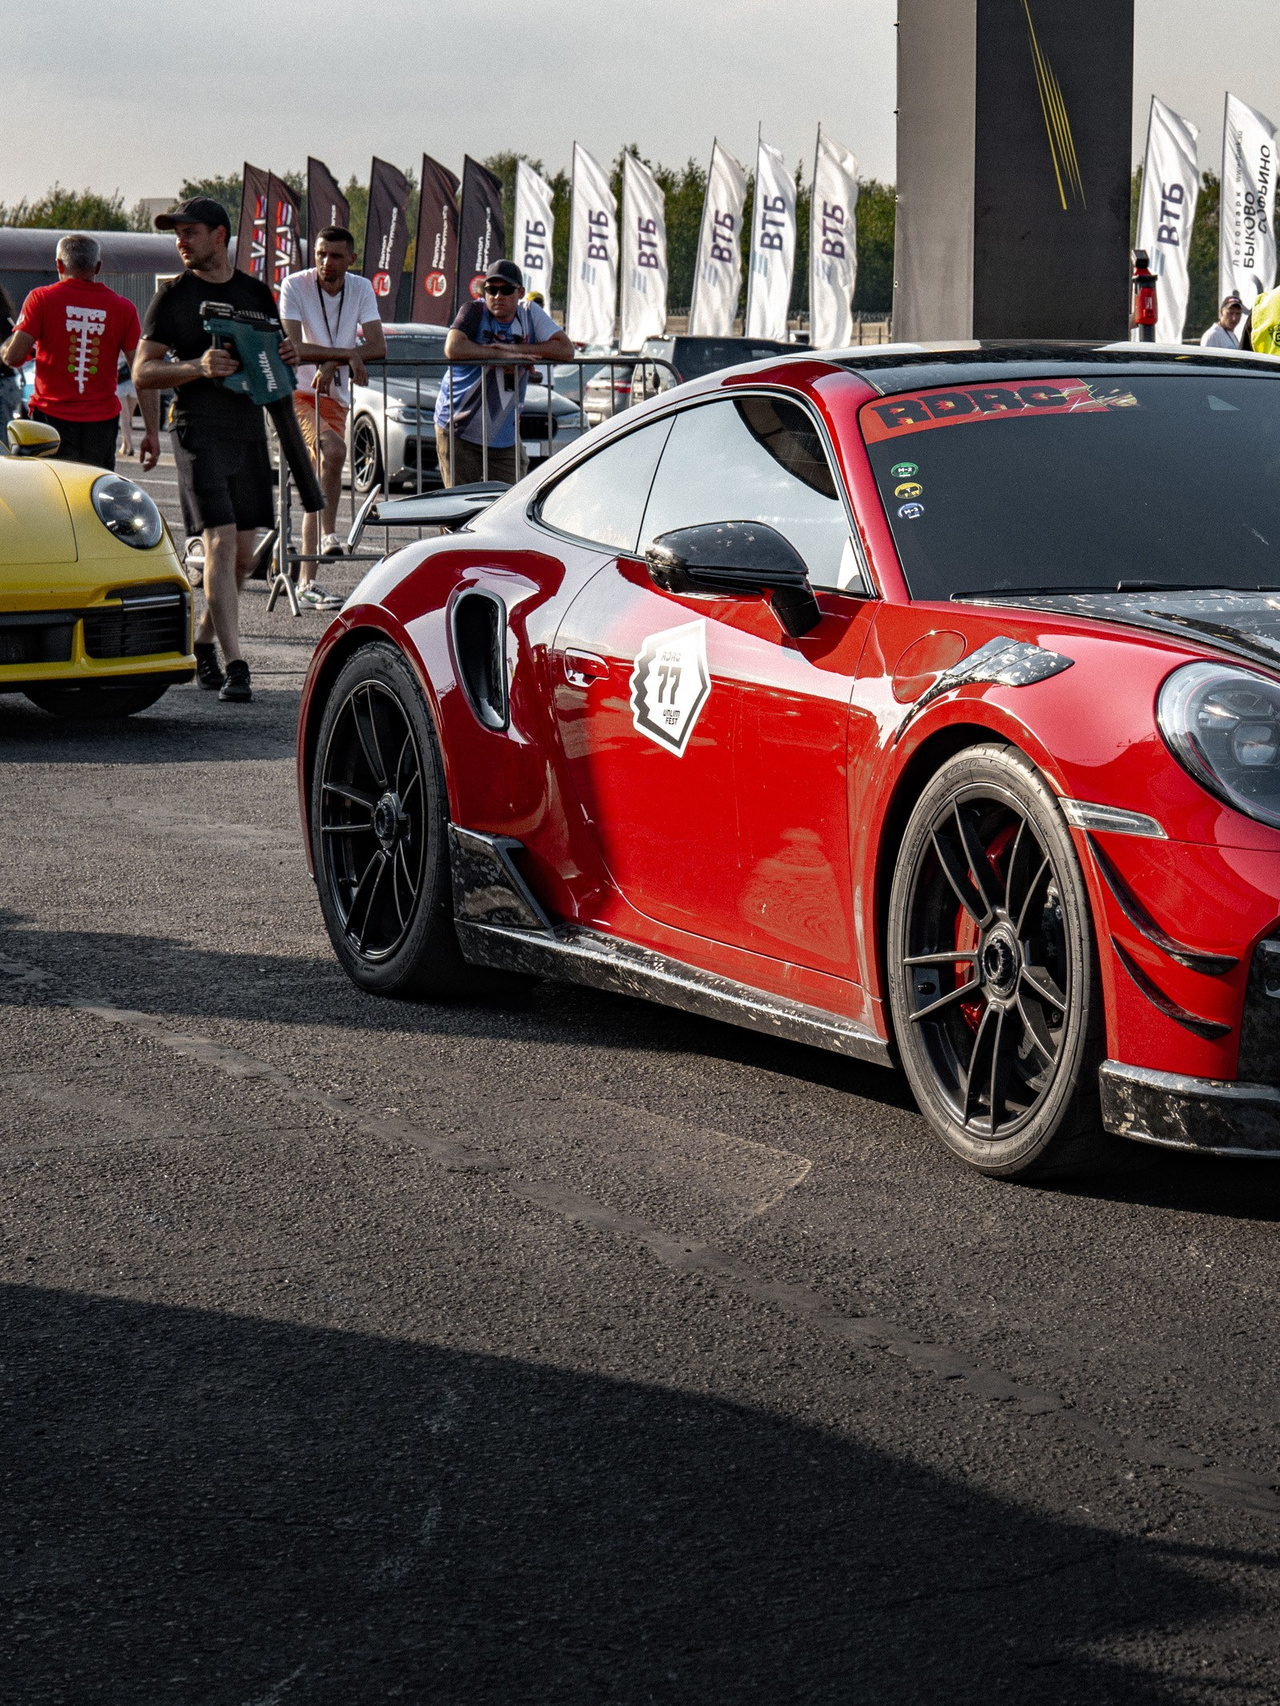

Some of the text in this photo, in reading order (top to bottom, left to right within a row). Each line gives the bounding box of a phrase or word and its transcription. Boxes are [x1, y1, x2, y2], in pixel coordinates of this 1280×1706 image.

[1157, 182, 1184, 246] ВТБ
[1256, 145, 1271, 234] СОФЬИНО
[524, 220, 546, 270] ВТБ
[588, 209, 608, 261] ВТБ
[638, 216, 659, 269] ВТБ
[711, 210, 734, 263] ВТБ
[760, 195, 785, 251] ВТБ
[821, 201, 845, 259] ВТБ
[1233, 191, 1242, 266] Логопарк
[1244, 191, 1255, 268] БЫКОВО
[657, 665, 682, 705] 77
